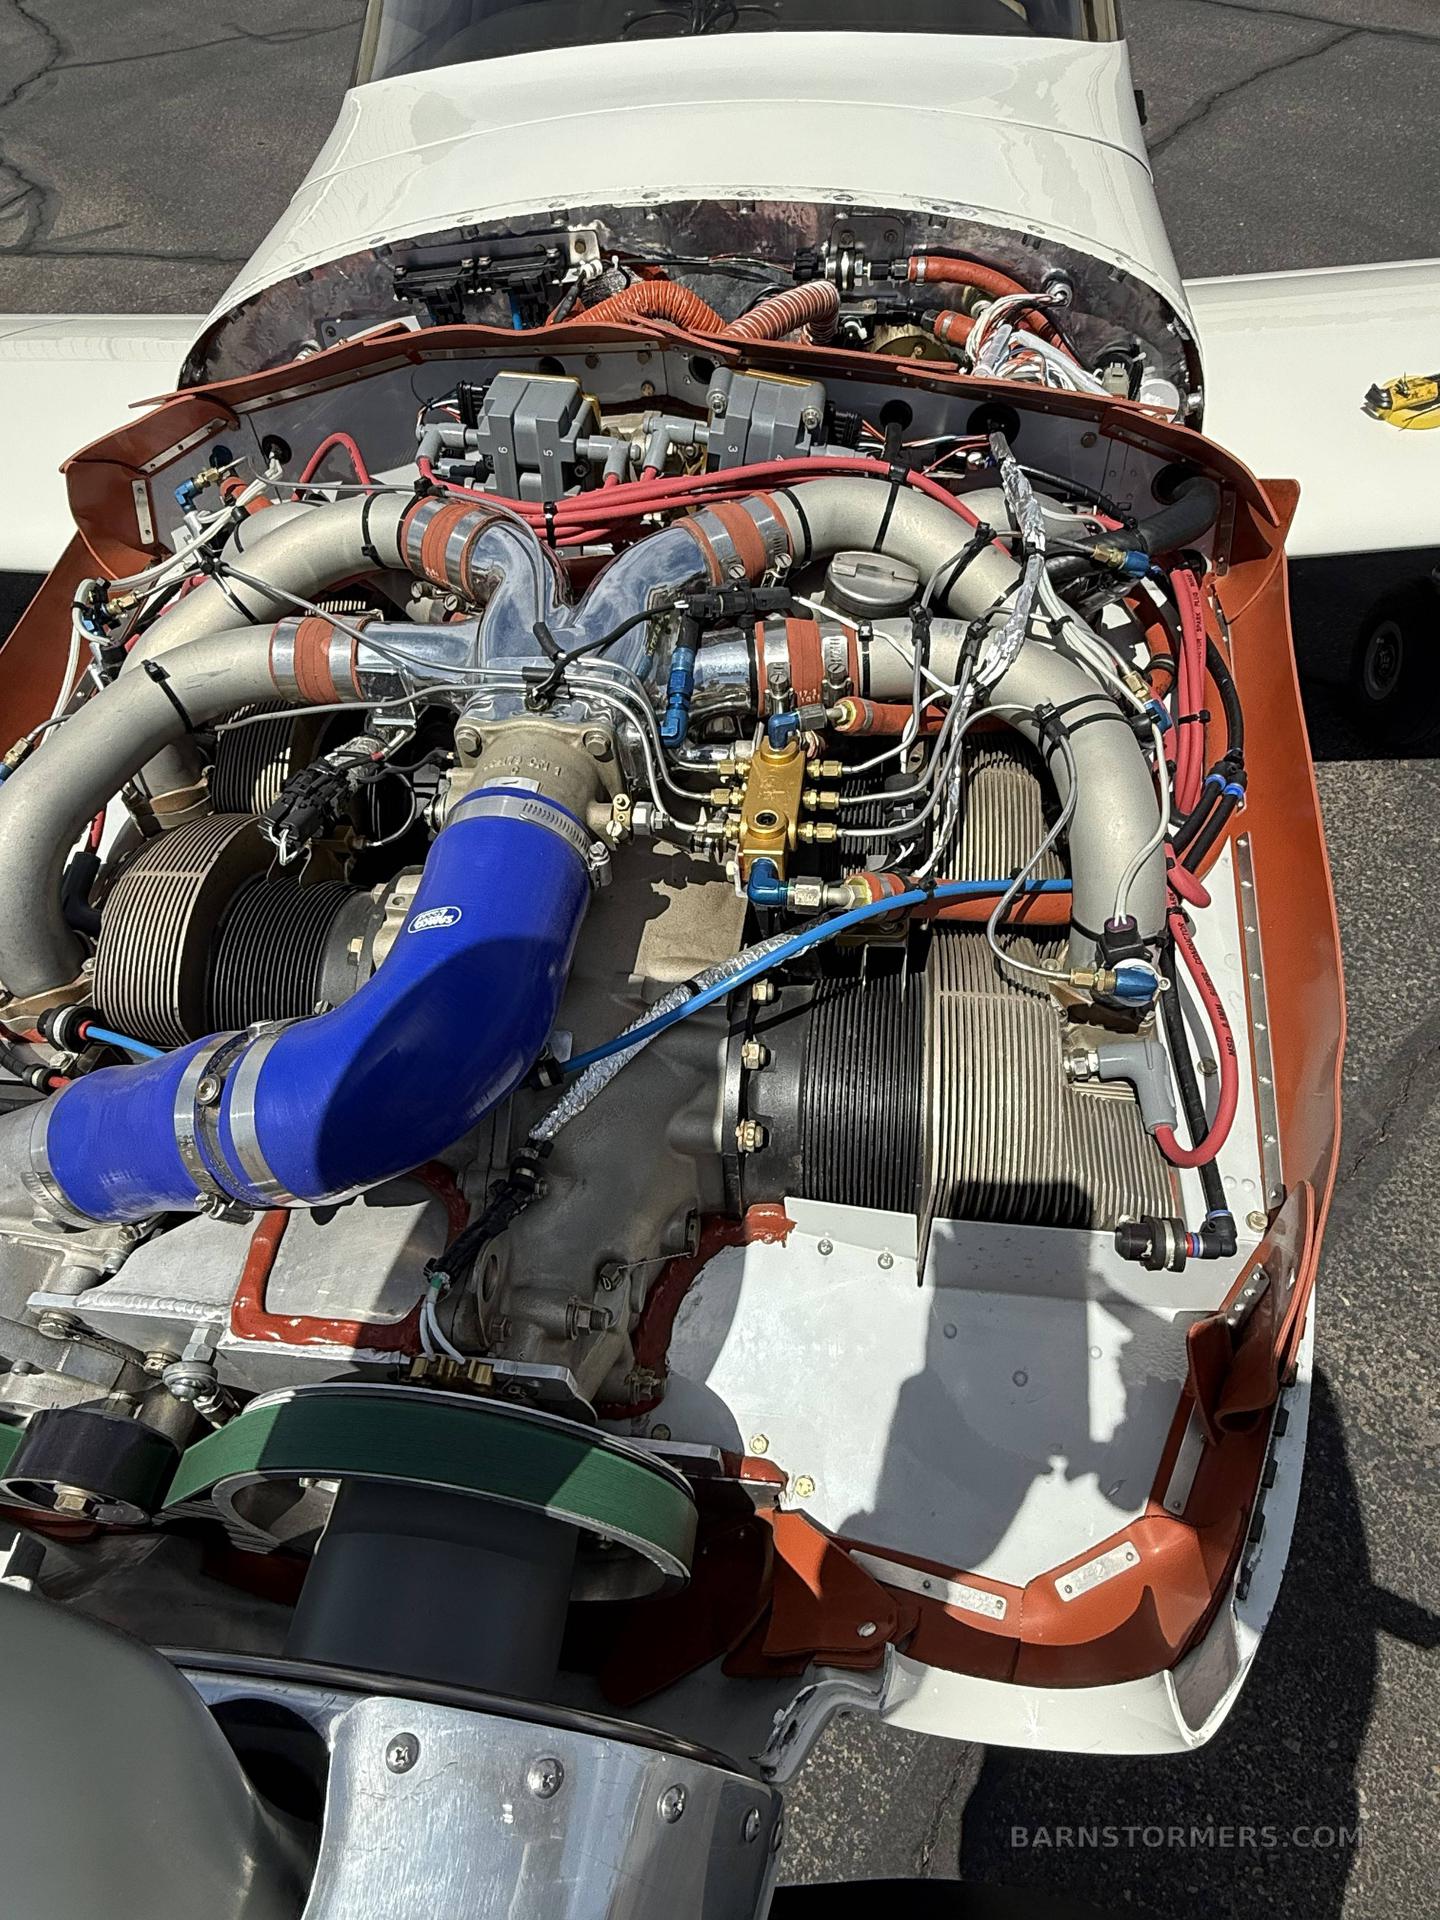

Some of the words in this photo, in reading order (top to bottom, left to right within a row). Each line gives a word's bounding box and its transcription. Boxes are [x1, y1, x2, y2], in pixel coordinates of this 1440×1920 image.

[543, 449, 553, 457] 5
[728, 445, 738, 453] 3
[1178, 922, 1203, 965] CONDUCTOR
[1225, 1036, 1236, 1056] MSD
